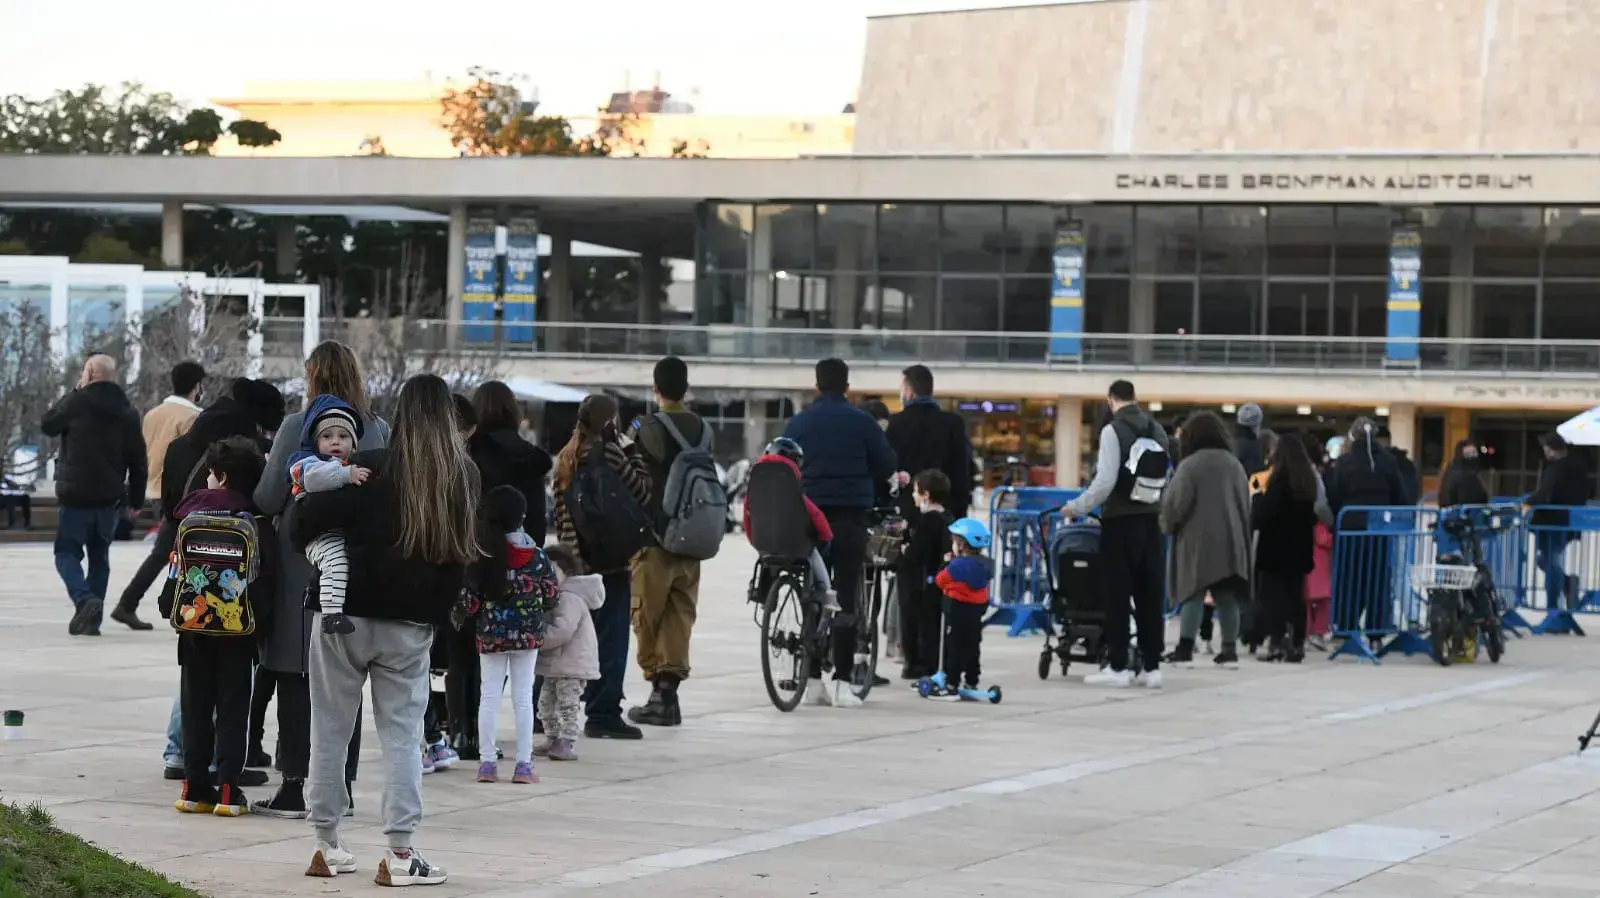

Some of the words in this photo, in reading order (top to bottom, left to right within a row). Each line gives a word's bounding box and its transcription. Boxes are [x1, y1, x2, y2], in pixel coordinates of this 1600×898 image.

[1115, 173, 1229, 189] CHARLES
[1241, 173, 1375, 189] BRONFMAN
[1384, 173, 1534, 189] AUDITORIUM
